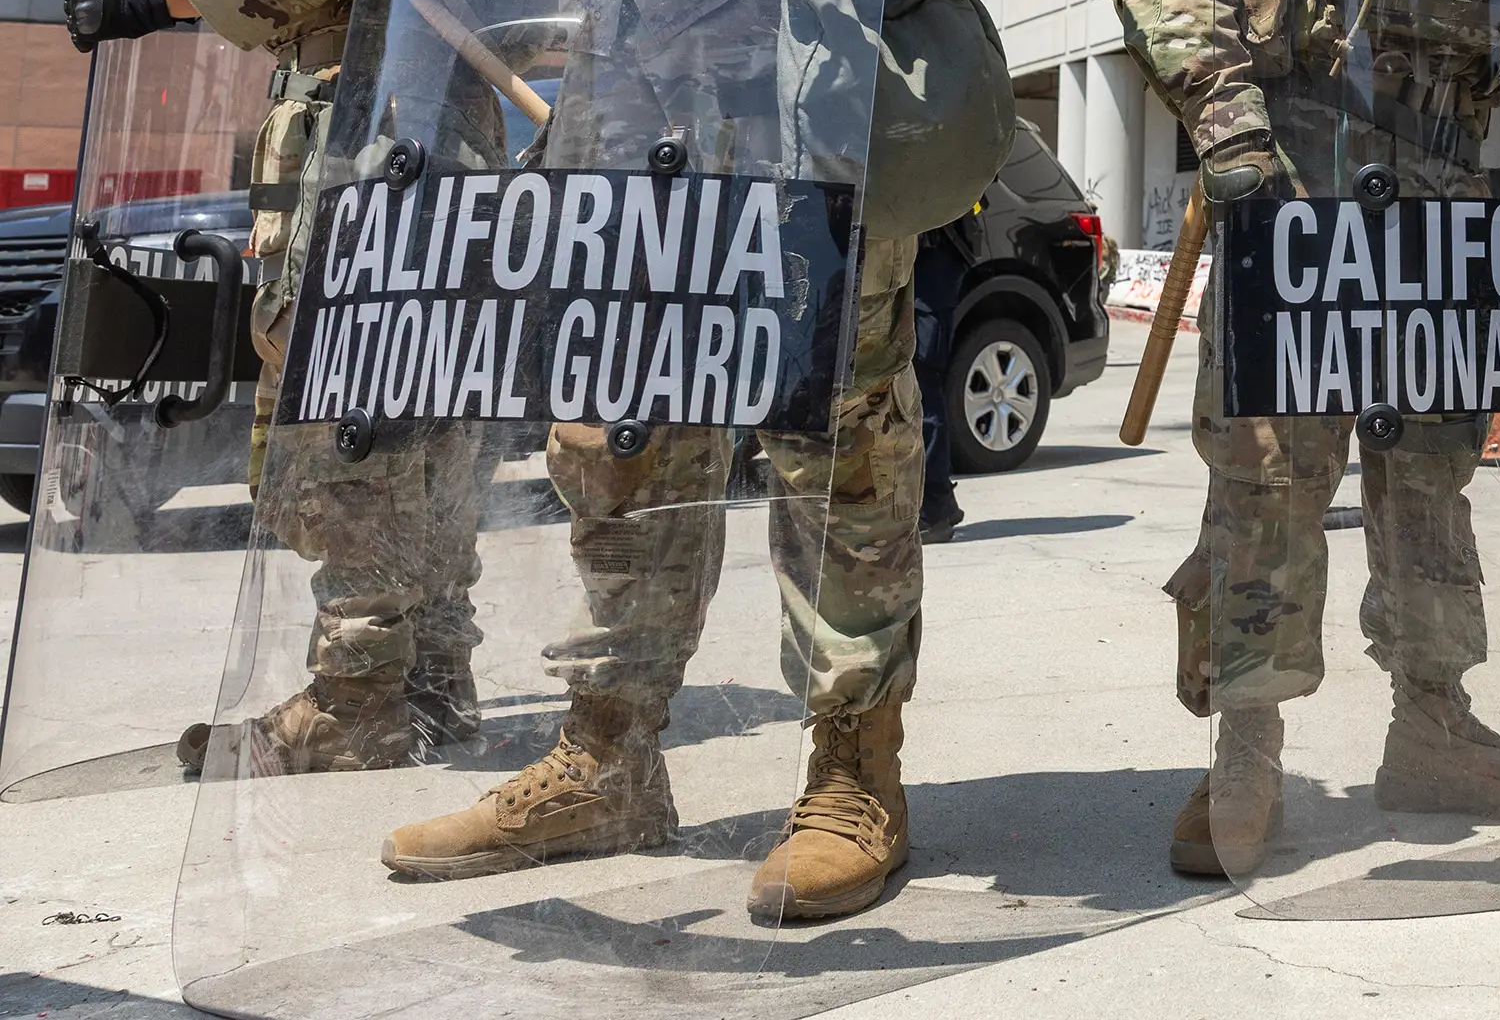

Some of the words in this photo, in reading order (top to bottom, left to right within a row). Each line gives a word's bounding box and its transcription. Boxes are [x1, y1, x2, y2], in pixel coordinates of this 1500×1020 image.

[323, 172, 786, 298] CALIFORNIA
[298, 298, 528, 421] NATIONAL
[549, 304, 781, 426] GUARD
